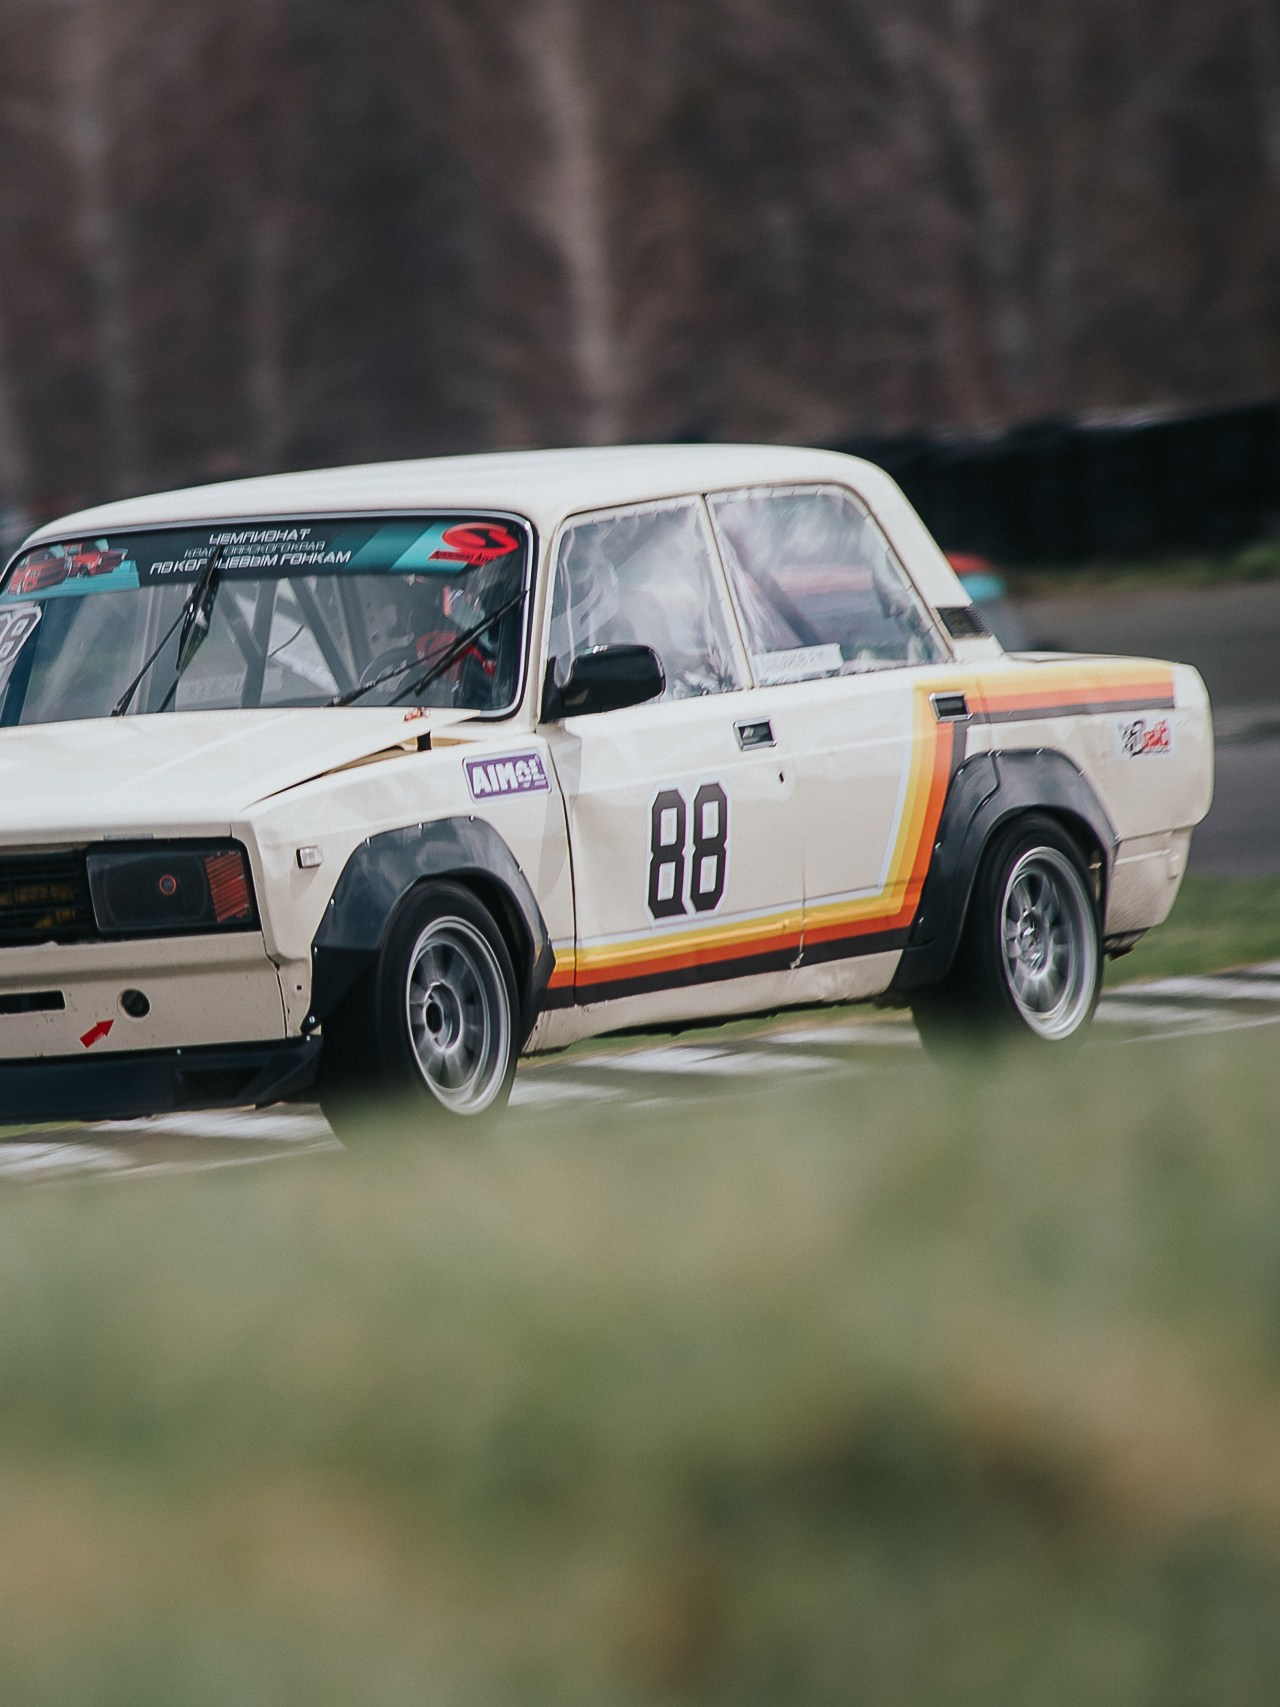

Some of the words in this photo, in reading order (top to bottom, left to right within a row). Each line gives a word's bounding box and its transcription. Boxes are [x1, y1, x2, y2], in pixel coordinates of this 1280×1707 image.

[209, 528, 311, 545] ЧЕМПИОНАТ
[150, 561, 175, 575] ПО
[172, 554, 278, 574] КОЛЦЕВЫМ
[279, 551, 352, 567] ГОНКАМ
[471, 757, 547, 795] AIMOL
[648, 782, 729, 920] 88
